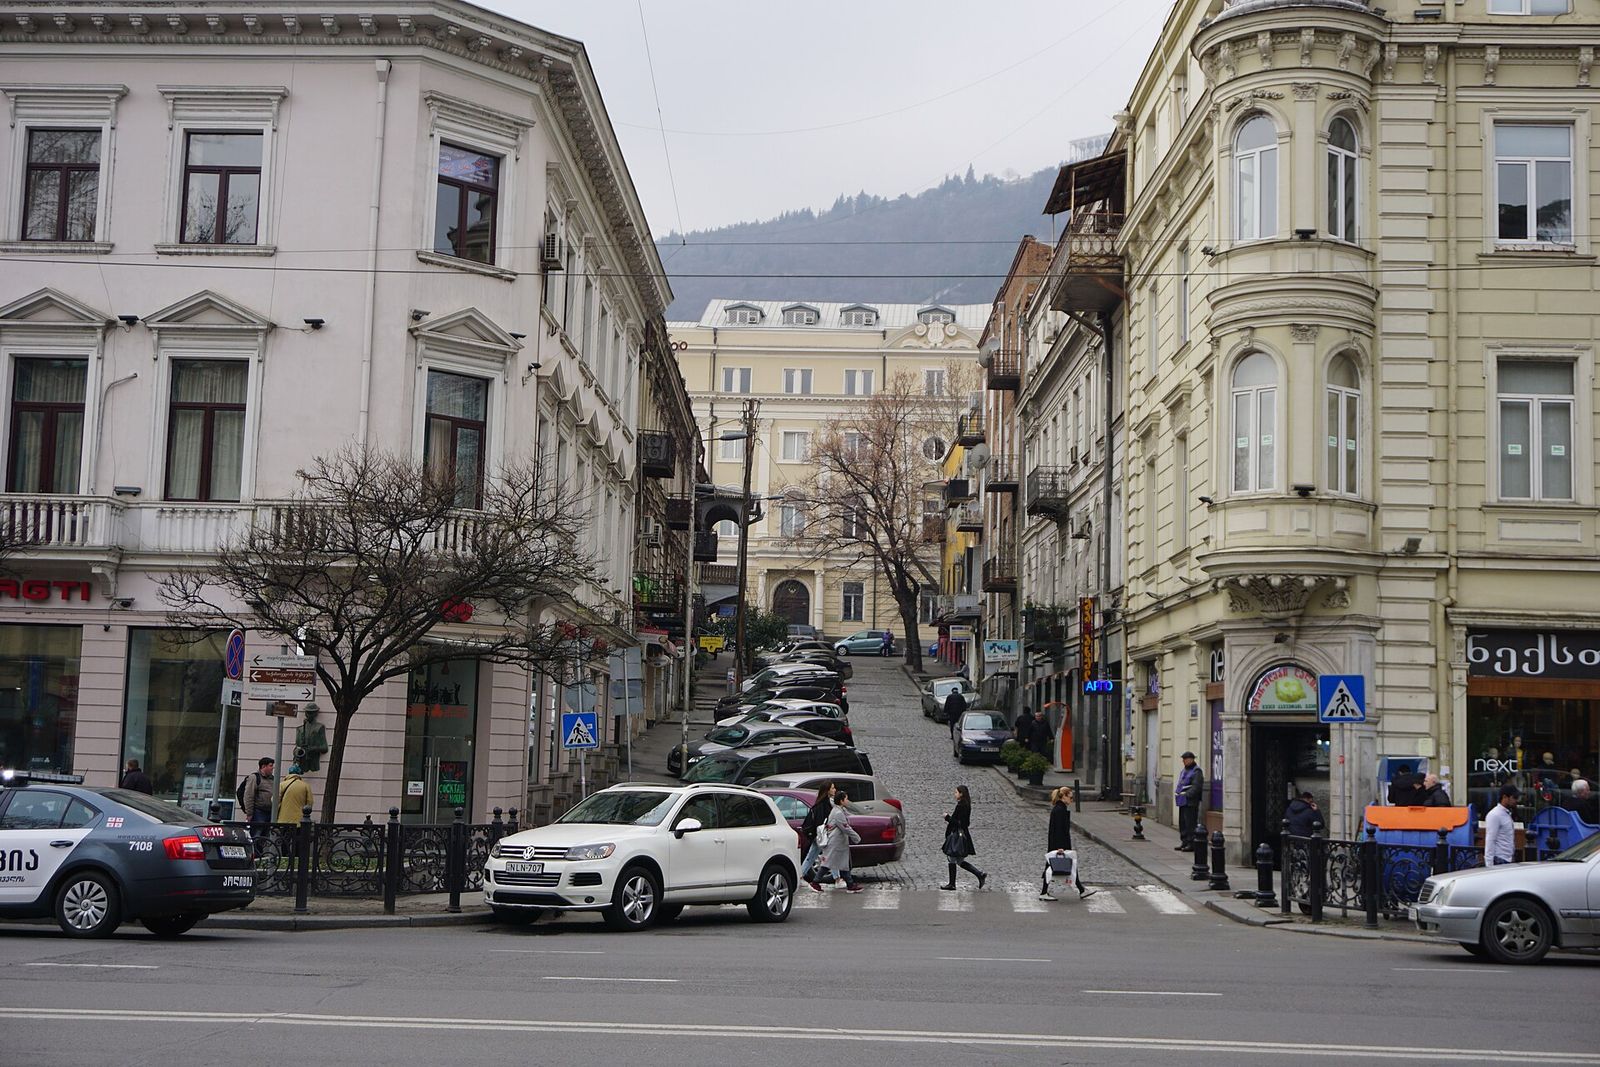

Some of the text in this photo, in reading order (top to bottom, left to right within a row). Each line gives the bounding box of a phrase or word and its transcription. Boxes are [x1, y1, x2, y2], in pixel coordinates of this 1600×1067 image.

[1475, 758, 1518, 773] next
[210, 827, 224, 837] 112
[129, 841, 153, 851] 7108
[510, 863, 541, 872] NLN-707
